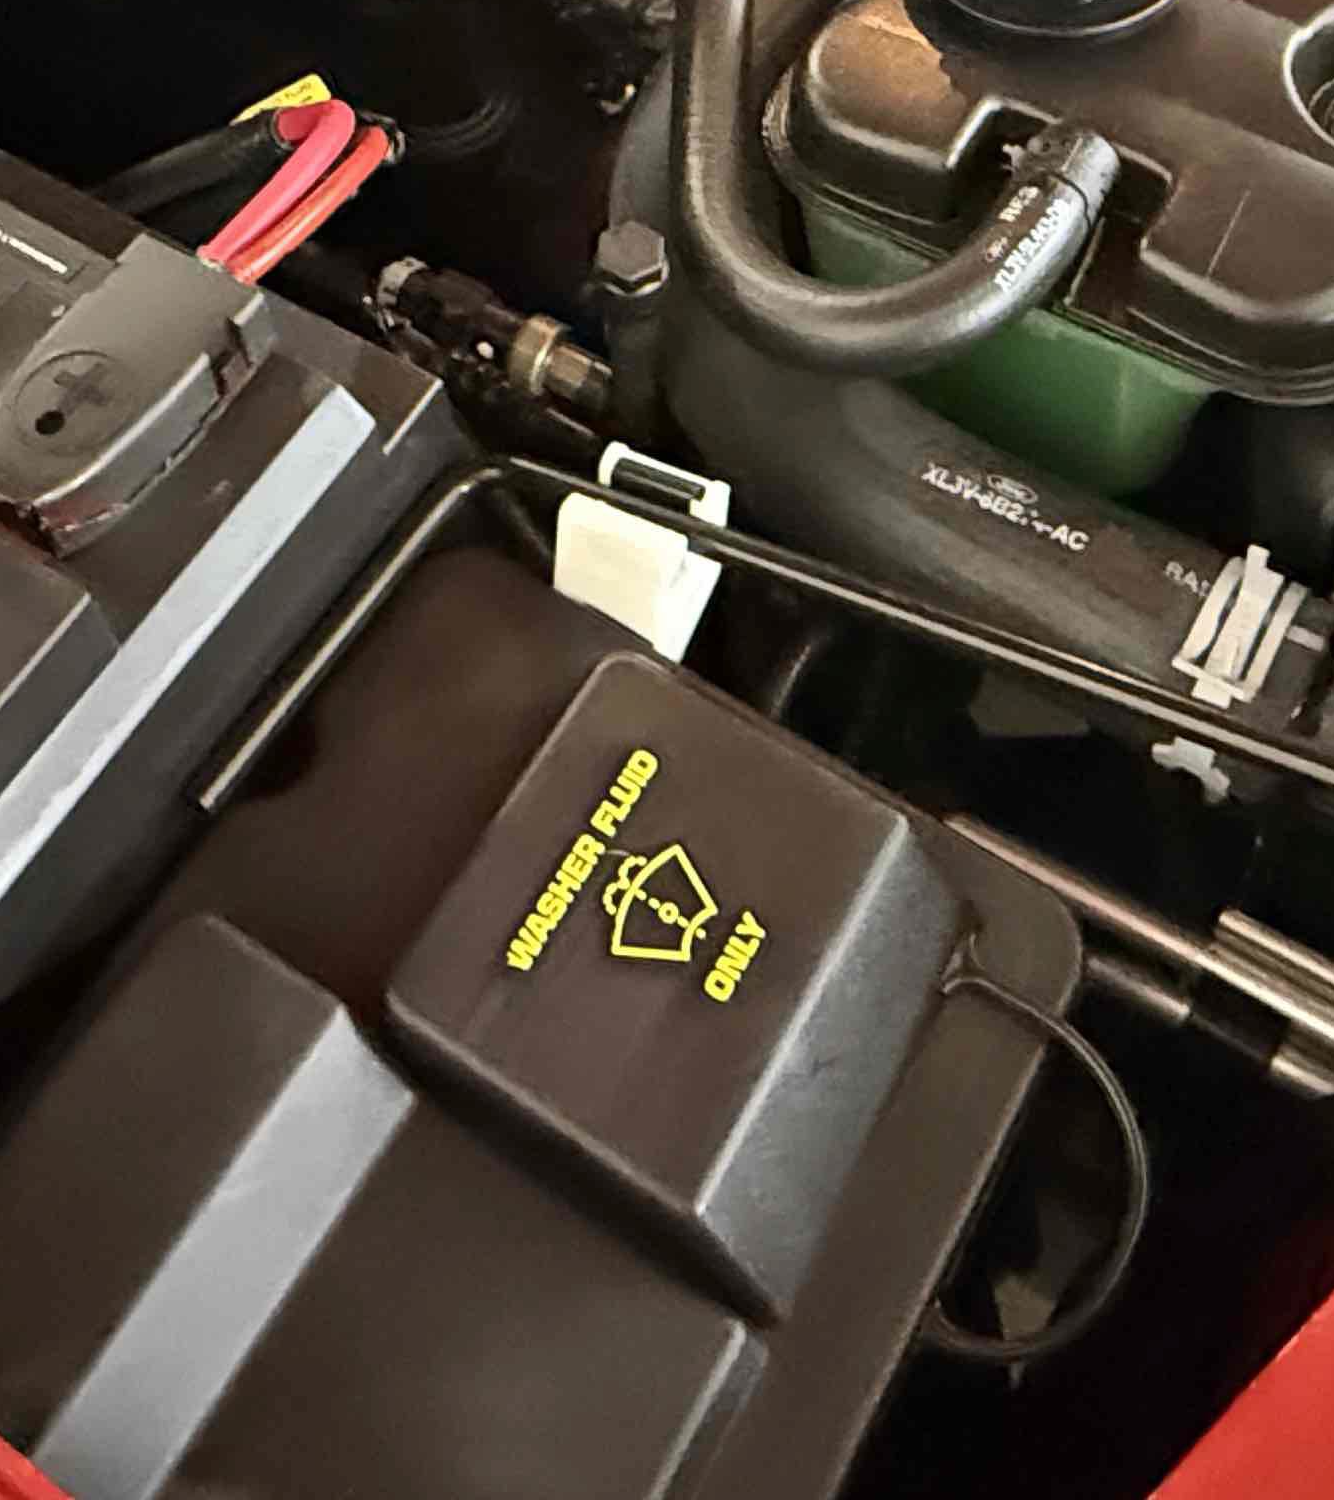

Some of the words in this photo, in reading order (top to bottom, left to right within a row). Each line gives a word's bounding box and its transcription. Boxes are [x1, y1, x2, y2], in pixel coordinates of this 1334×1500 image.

[507, 834, 605, 971] WASHER
[590, 749, 658, 837] FLUID
[704, 910, 766, 1002] ONLY
